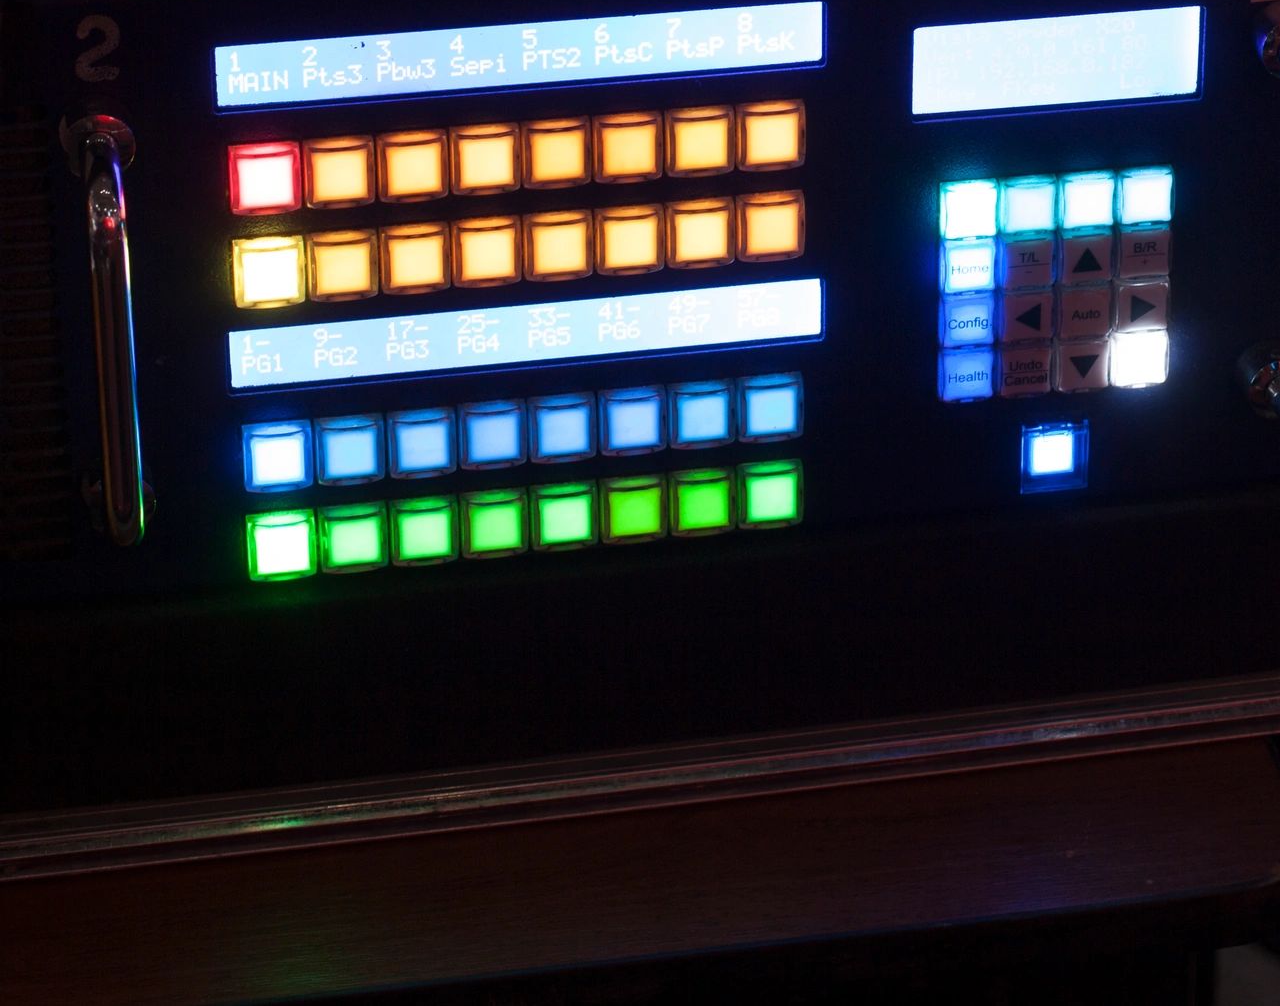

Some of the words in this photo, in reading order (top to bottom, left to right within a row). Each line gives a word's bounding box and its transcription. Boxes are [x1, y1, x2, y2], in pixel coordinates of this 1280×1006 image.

[74, 13, 122, 83] 2
[230, 51, 241, 72] 1
[302, 45, 319, 67] 2
[376, 40, 391, 61] 3
[449, 34, 465, 54] 4
[522, 29, 537, 49] 5
[594, 24, 610, 44] 6
[666, 18, 682, 39] 7
[736, 13, 753, 33] 8
[228, 70, 289, 94] MAIN
[302, 64, 362, 88] Pts3
[376, 58, 436, 82] Pbw3
[449, 54, 507, 76] Sepi
[522, 47, 582, 70] PTS2
[594, 41, 653, 66] PtsC
[666, 36, 725, 60] PtsP
[736, 30, 796, 55] PtsK
[1133, 242, 1158, 254] B/R
[1020, 252, 1040, 264] T/L
[951, 264, 989, 275] Home
[1071, 309, 1101, 321] Auto
[242, 335, 272, 355] 1-
[312, 328, 343, 349] 9-
[387, 320, 429, 341] 17-
[457, 313, 500, 335] 25-
[528, 307, 571, 328] 33-
[598, 300, 641, 321] 41-
[240, 354, 284, 375] PG1
[313, 346, 358, 370] PG2
[386, 339, 430, 362] PG3
[457, 333, 500, 355] PG4
[527, 325, 572, 349] PG5
[598, 319, 641, 342] PG6
[668, 313, 711, 336] PG7
[1009, 360, 1043, 372] Undo
[948, 370, 989, 384] Health
[1004, 373, 1048, 387] Cancel
